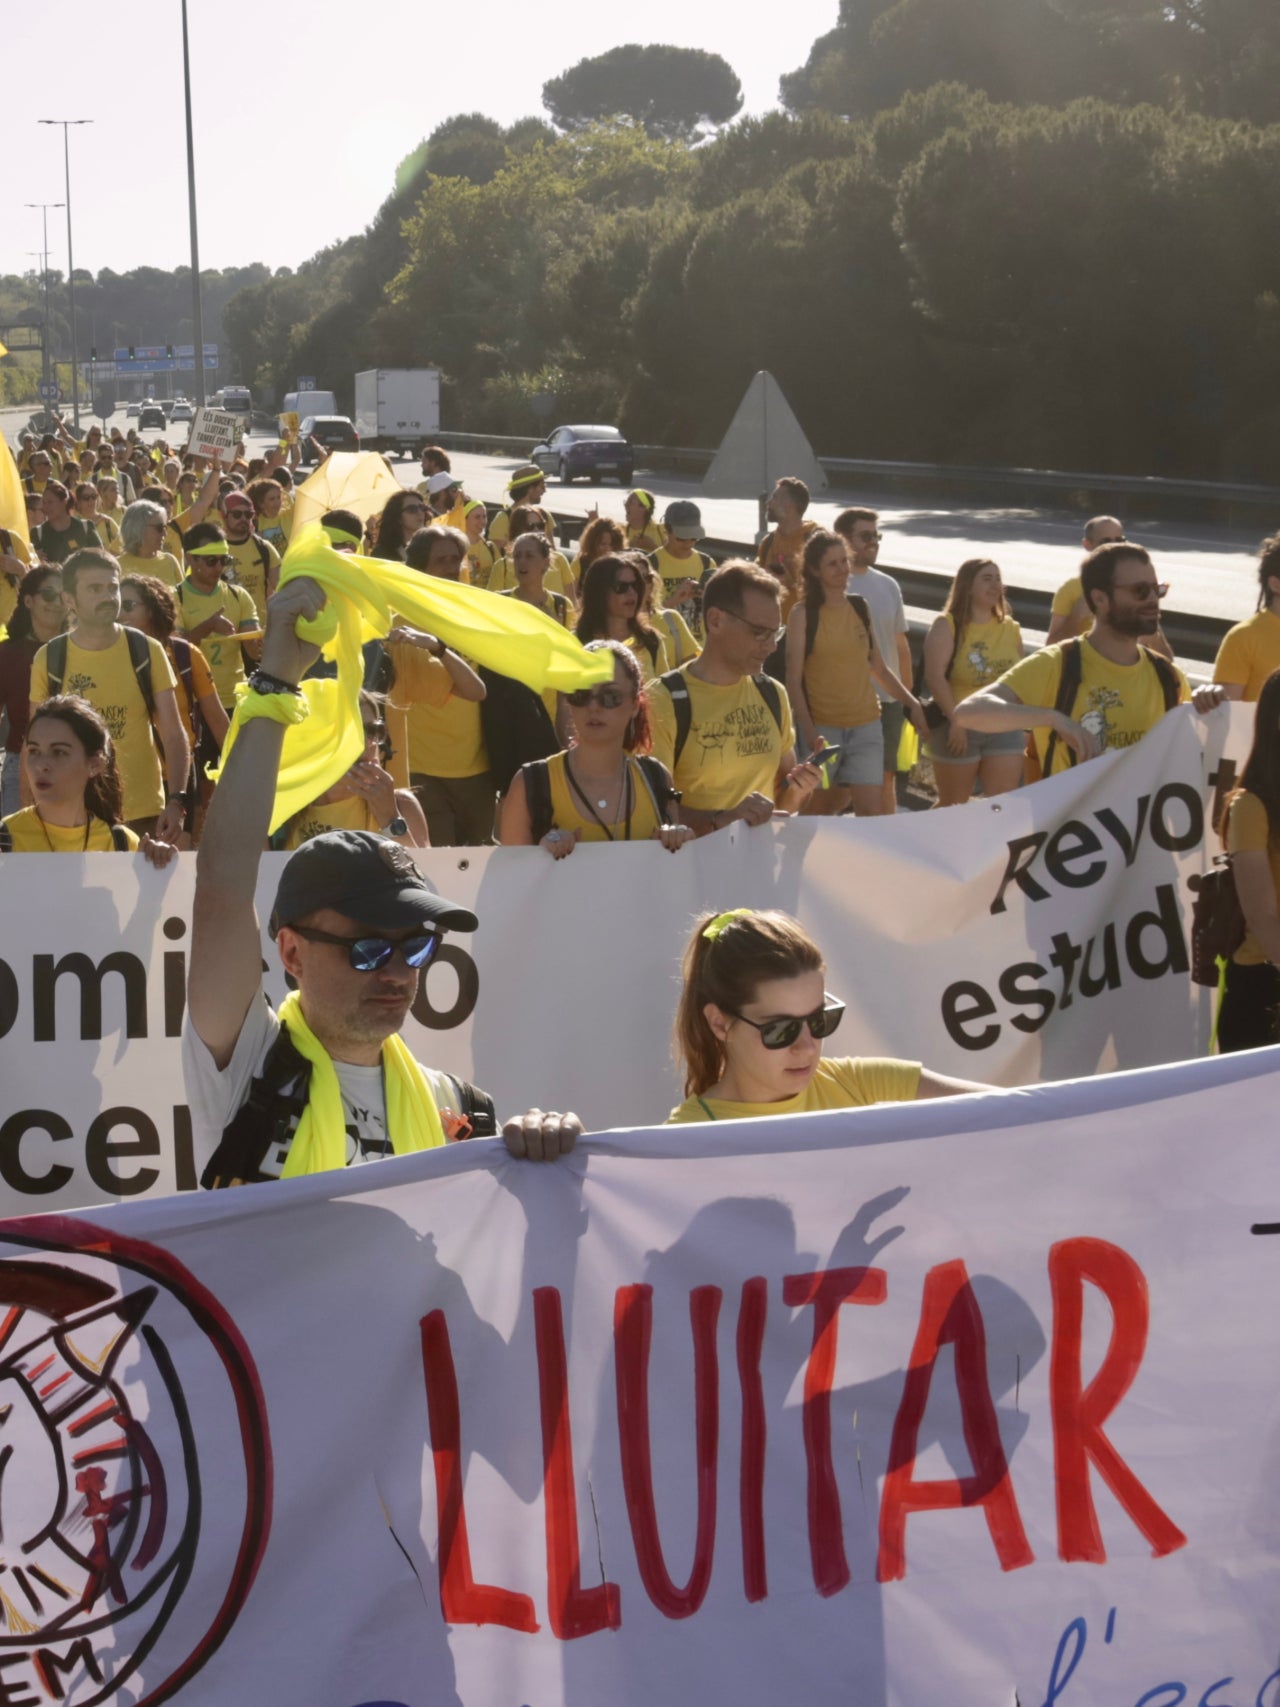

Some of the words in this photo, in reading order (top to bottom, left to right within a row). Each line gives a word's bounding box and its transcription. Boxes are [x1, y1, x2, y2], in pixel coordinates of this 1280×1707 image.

[210, 643, 223, 666] 2
[941, 873, 1203, 1050] estud
[420, 1236, 1188, 1640] LLUITAR
